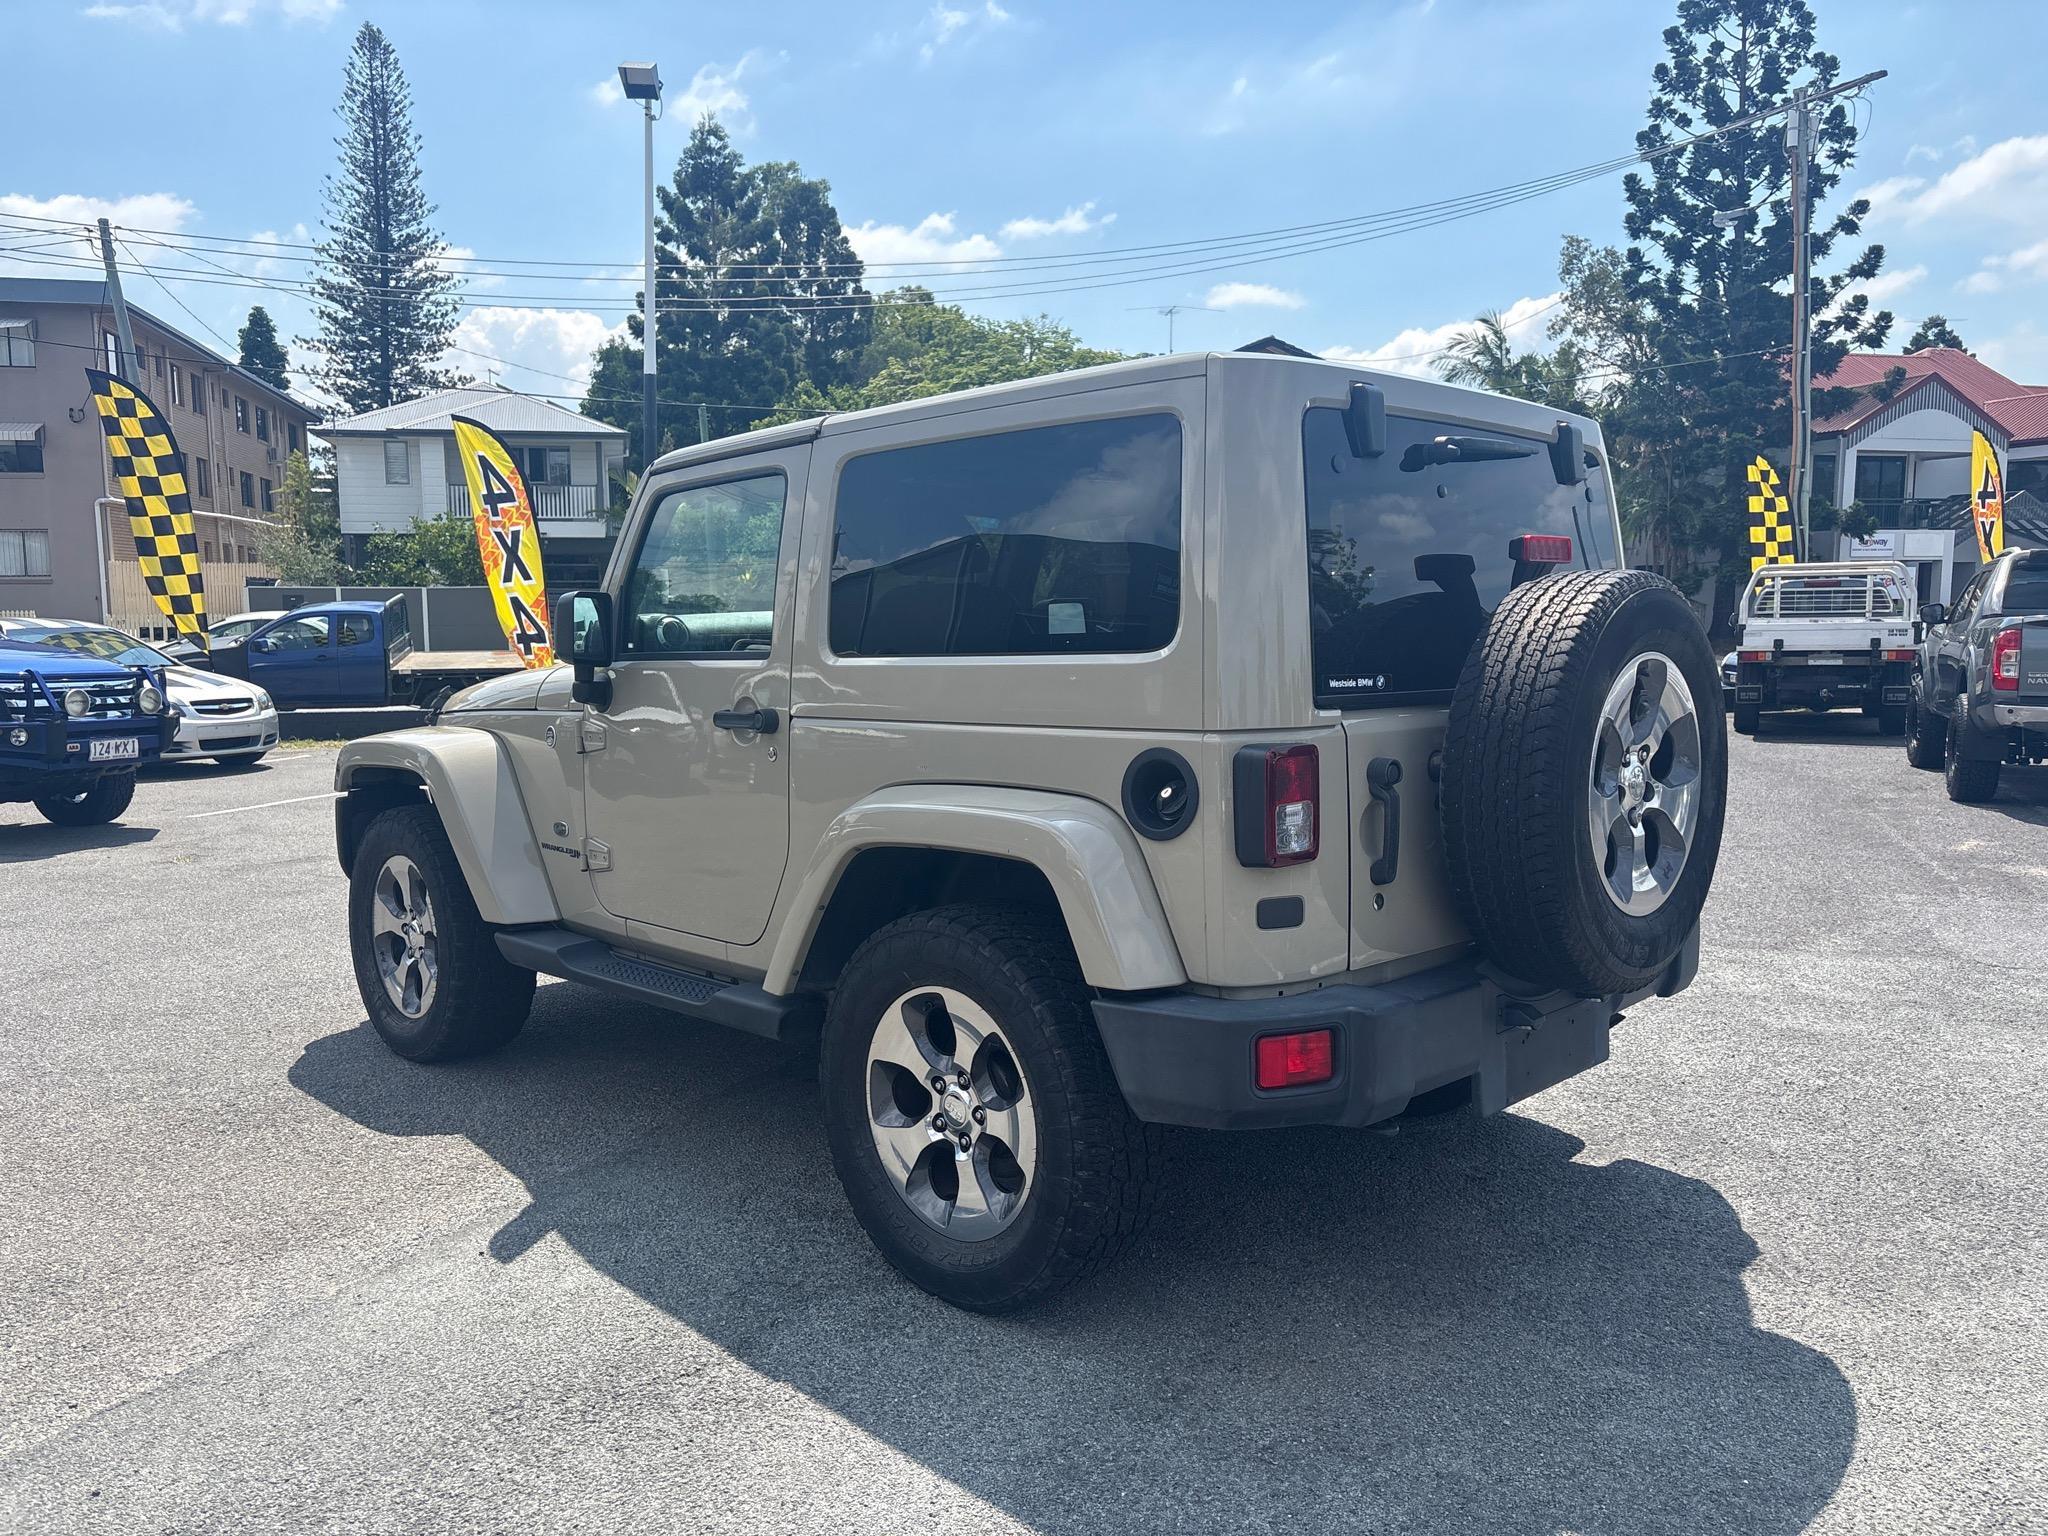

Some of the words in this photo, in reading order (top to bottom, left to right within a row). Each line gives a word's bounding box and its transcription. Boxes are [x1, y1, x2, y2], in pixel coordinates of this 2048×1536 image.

[1329, 679, 1356, 688] Westside
[1357, 678, 1373, 687] BMW
[541, 842, 573, 855] WRANGLER
